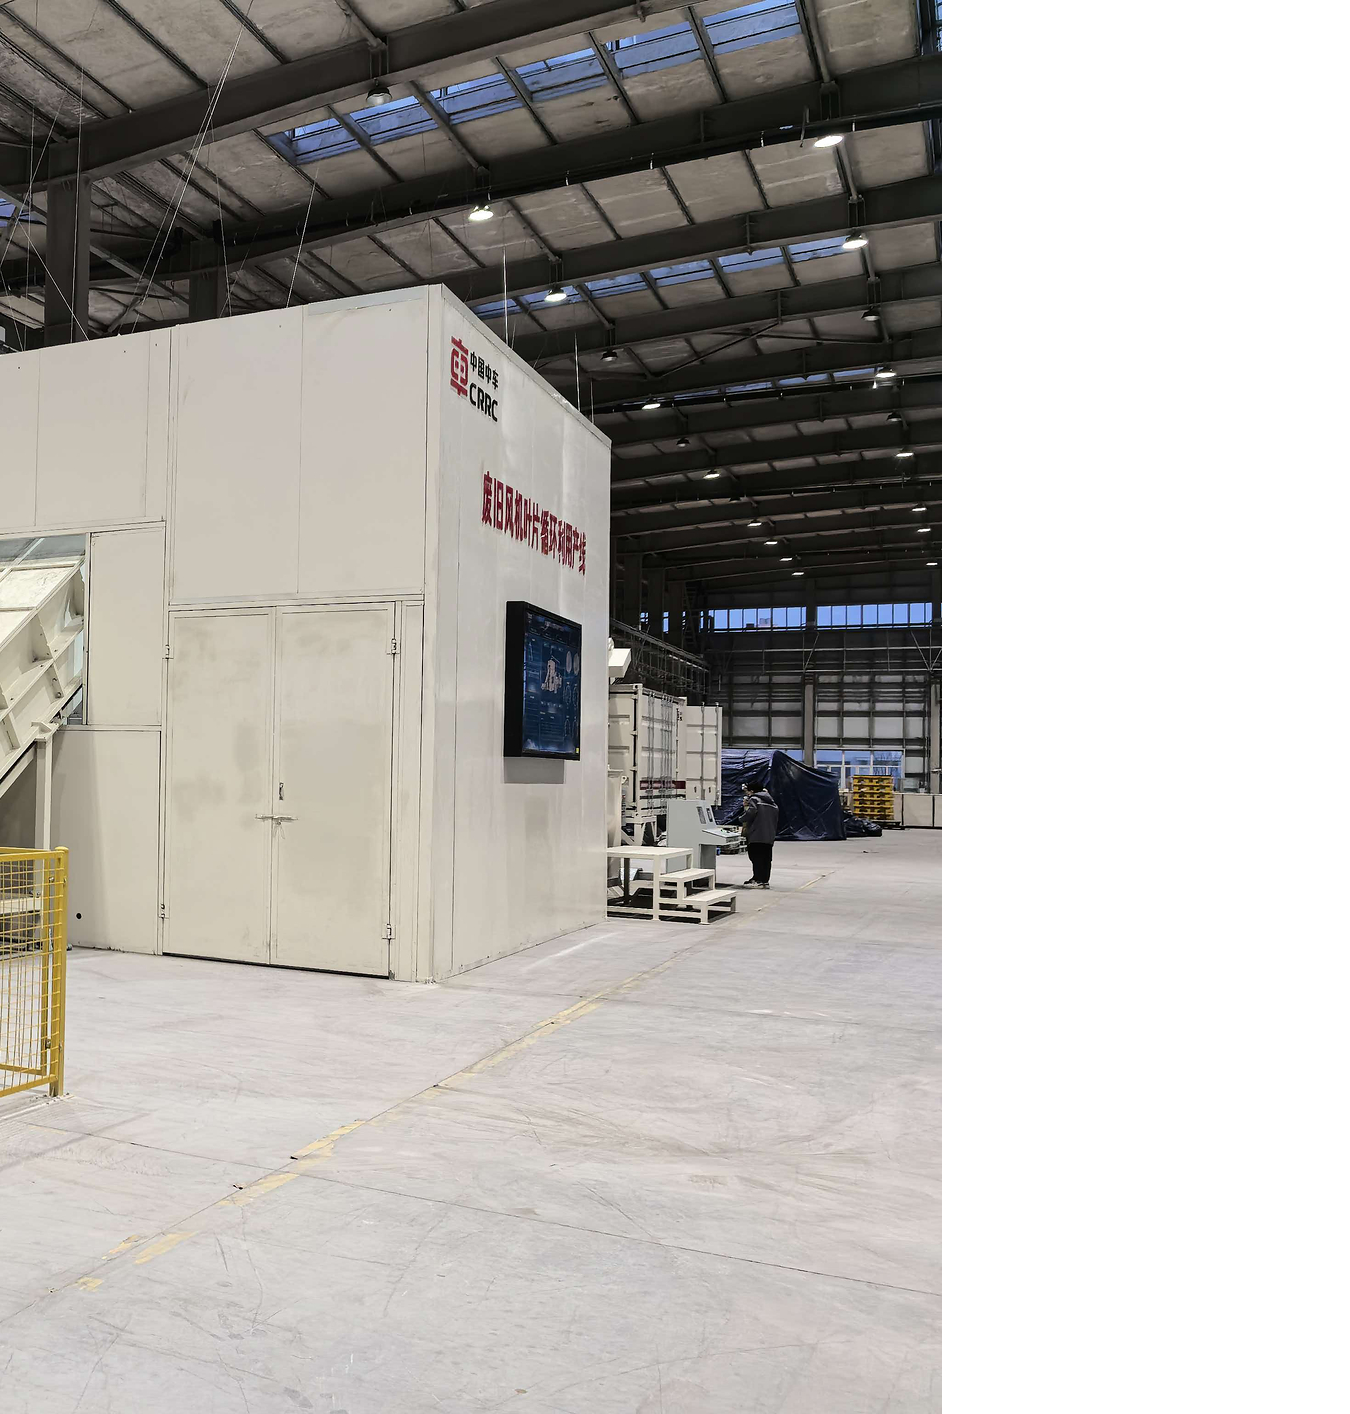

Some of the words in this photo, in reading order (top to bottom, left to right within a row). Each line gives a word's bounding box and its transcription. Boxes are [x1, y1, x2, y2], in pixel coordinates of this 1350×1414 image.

[470, 351, 499, 390] 中国中车
[469, 382, 498, 422] CRRC
[481, 470, 587, 576] 废旧风机叶片循环利用产线
